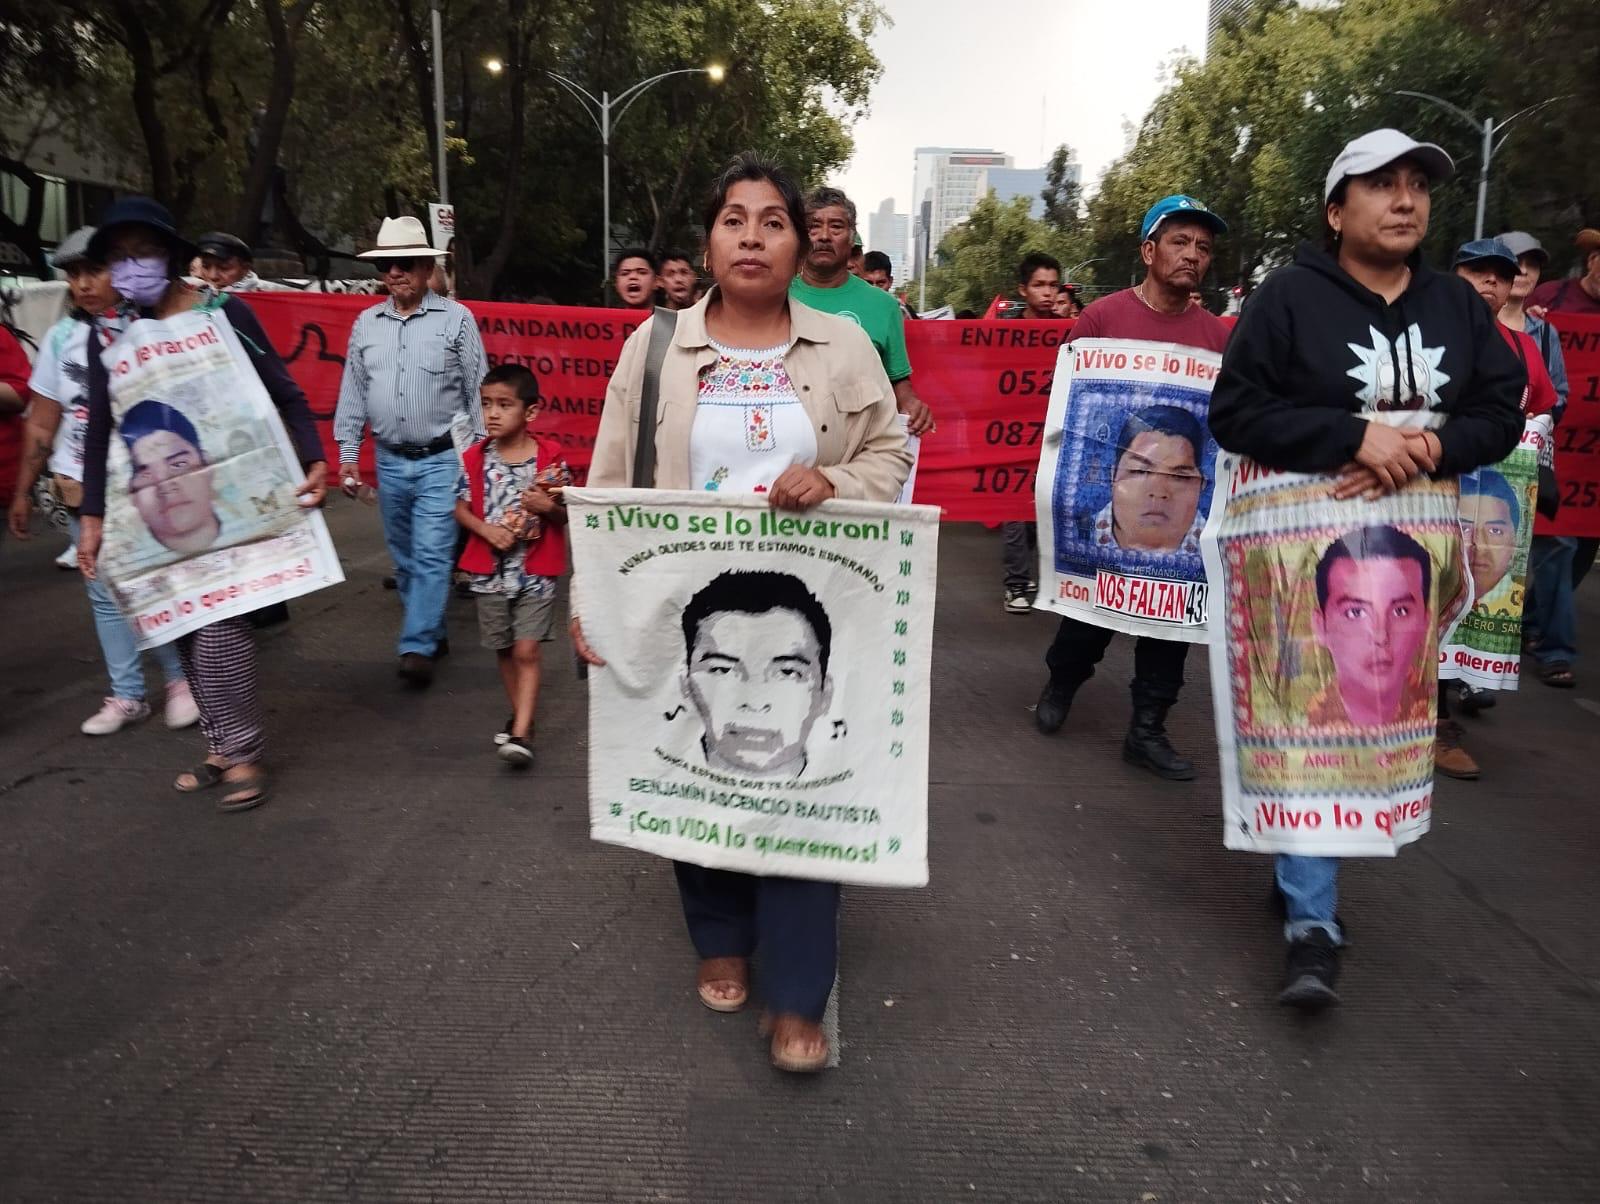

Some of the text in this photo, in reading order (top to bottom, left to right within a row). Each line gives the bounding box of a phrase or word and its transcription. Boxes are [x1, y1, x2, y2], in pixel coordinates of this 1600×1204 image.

[561, 357, 617, 377] FEDE
[1075, 349, 1127, 371] ¡Vivo
[1133, 355, 1156, 370] se
[1162, 354, 1179, 374] lo
[986, 420, 1045, 446] 087
[1558, 427, 1600, 454] 12
[972, 466, 1035, 493] 107
[1561, 480, 1600, 508] 25
[607, 504, 890, 541] ¡Vivo se lo llevaron!
[618, 548, 657, 576] NUNCA
[709, 540, 735, 551] QUE
[739, 540, 754, 551] TE
[758, 540, 816, 557] ESTAMOS
[818, 548, 885, 593] ESPERANDO
[1096, 572, 1126, 609] NOS
[1129, 580, 1188, 619] FALTAN
[1256, 801, 1322, 833] ¡Vivo
[1333, 803, 1363, 829] lo
[629, 810, 877, 863] ¡Con VIDA lo queremos!
